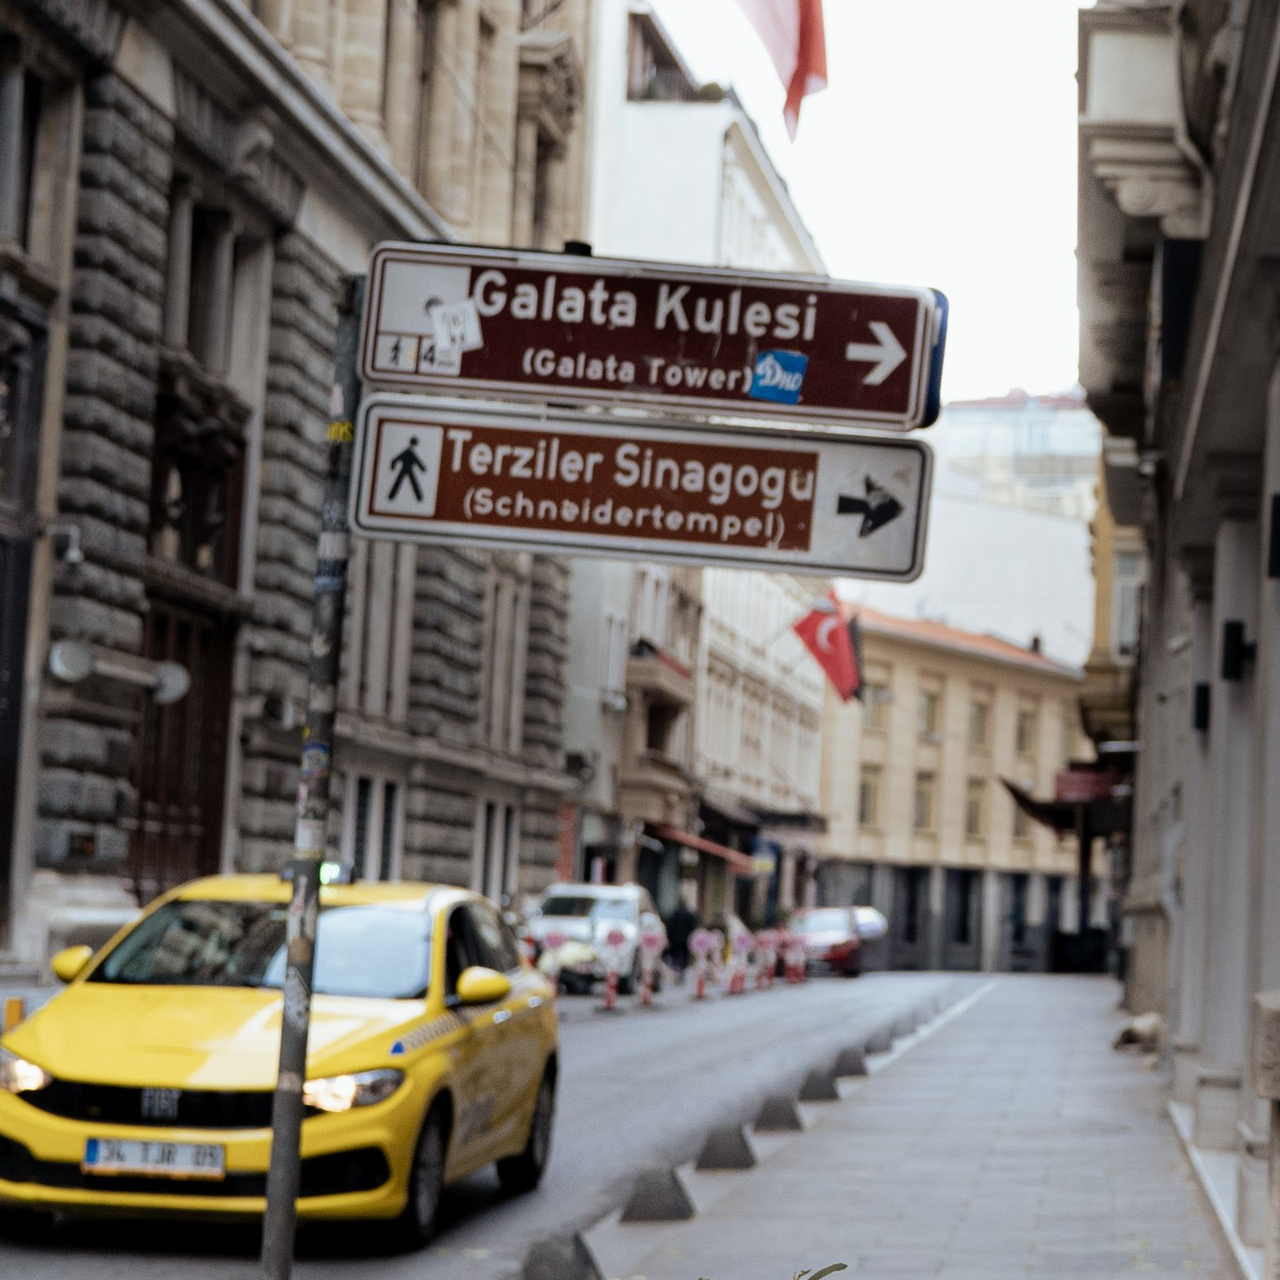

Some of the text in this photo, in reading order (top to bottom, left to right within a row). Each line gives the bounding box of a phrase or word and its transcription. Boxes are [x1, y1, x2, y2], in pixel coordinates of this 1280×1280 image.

[473, 269, 819, 341] Galata Kulesi
[522, 347, 754, 394] (Galata Tower)
[446, 429, 815, 510] Terziler Sinagogu
[463, 487, 786, 545] (Schneidertempel)
